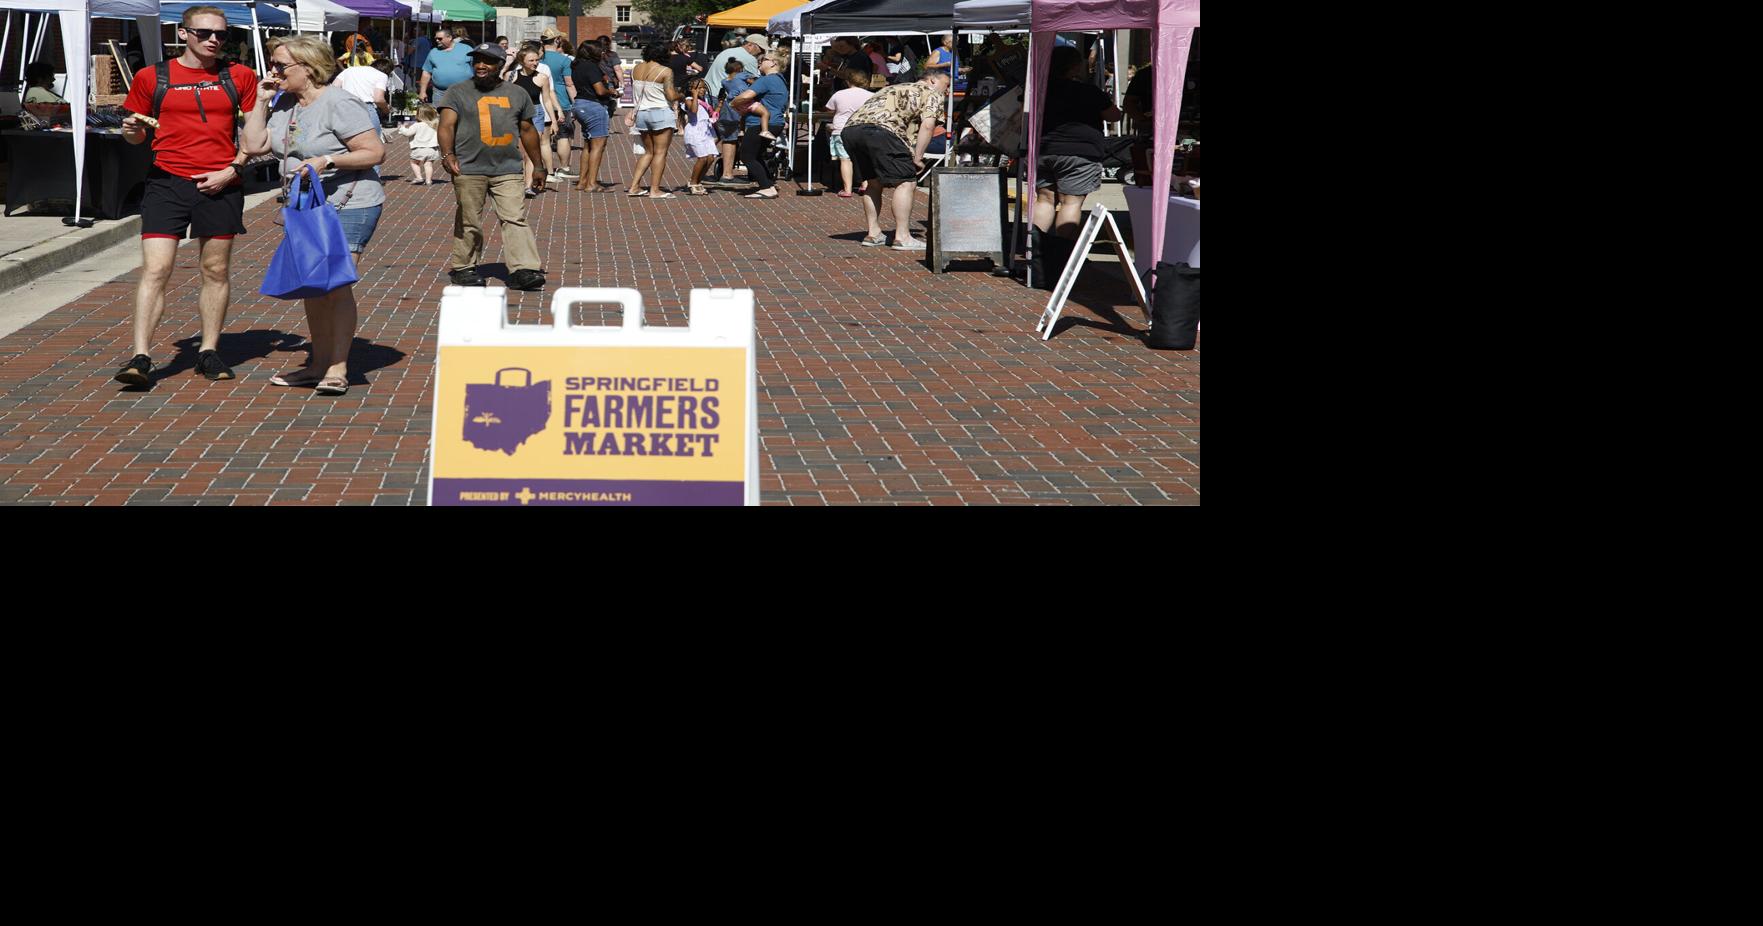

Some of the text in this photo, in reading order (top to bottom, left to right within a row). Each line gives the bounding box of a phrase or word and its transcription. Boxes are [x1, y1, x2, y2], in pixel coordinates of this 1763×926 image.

[477, 96, 513, 147] C
[565, 377, 719, 392] SPRINGFIELD
[564, 395, 720, 429] FARMERS
[563, 432, 719, 457] MARKET
[460, 491, 632, 502] PRESENTED BY MERCYHEALTH
